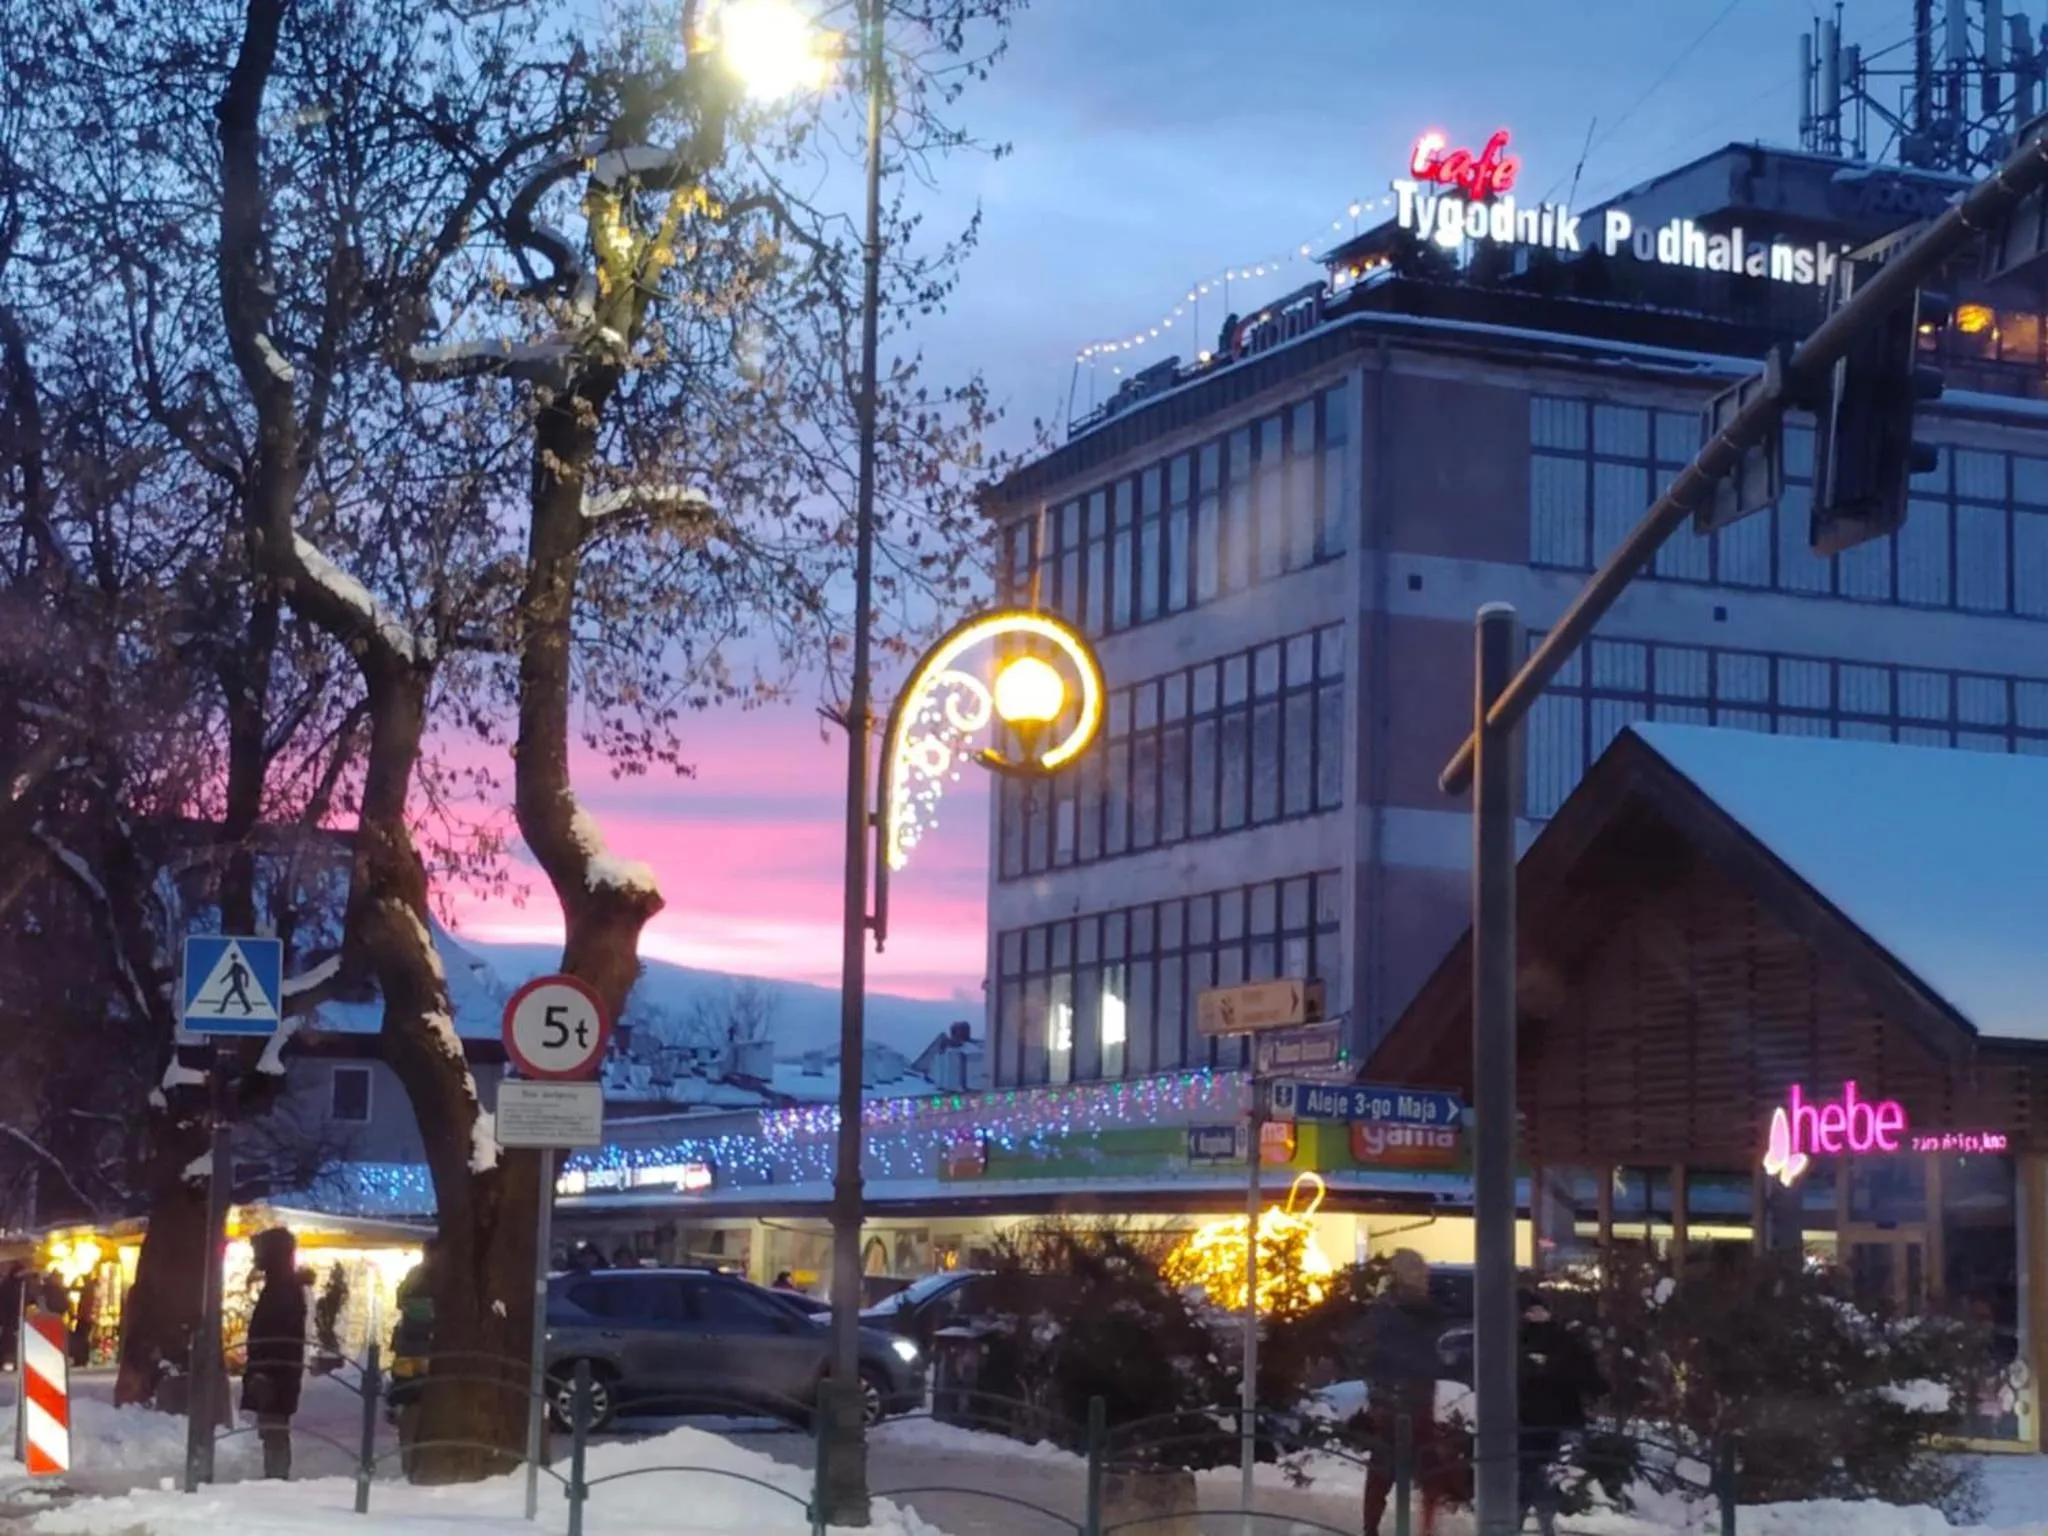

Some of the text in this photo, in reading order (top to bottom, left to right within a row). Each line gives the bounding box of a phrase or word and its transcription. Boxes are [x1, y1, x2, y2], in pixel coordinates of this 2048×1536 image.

[1393, 178, 1581, 252] Tygodnik
[1307, 1089, 1437, 1124] Aleje 3-go Maja
[1790, 1080, 1906, 1153] hebe
